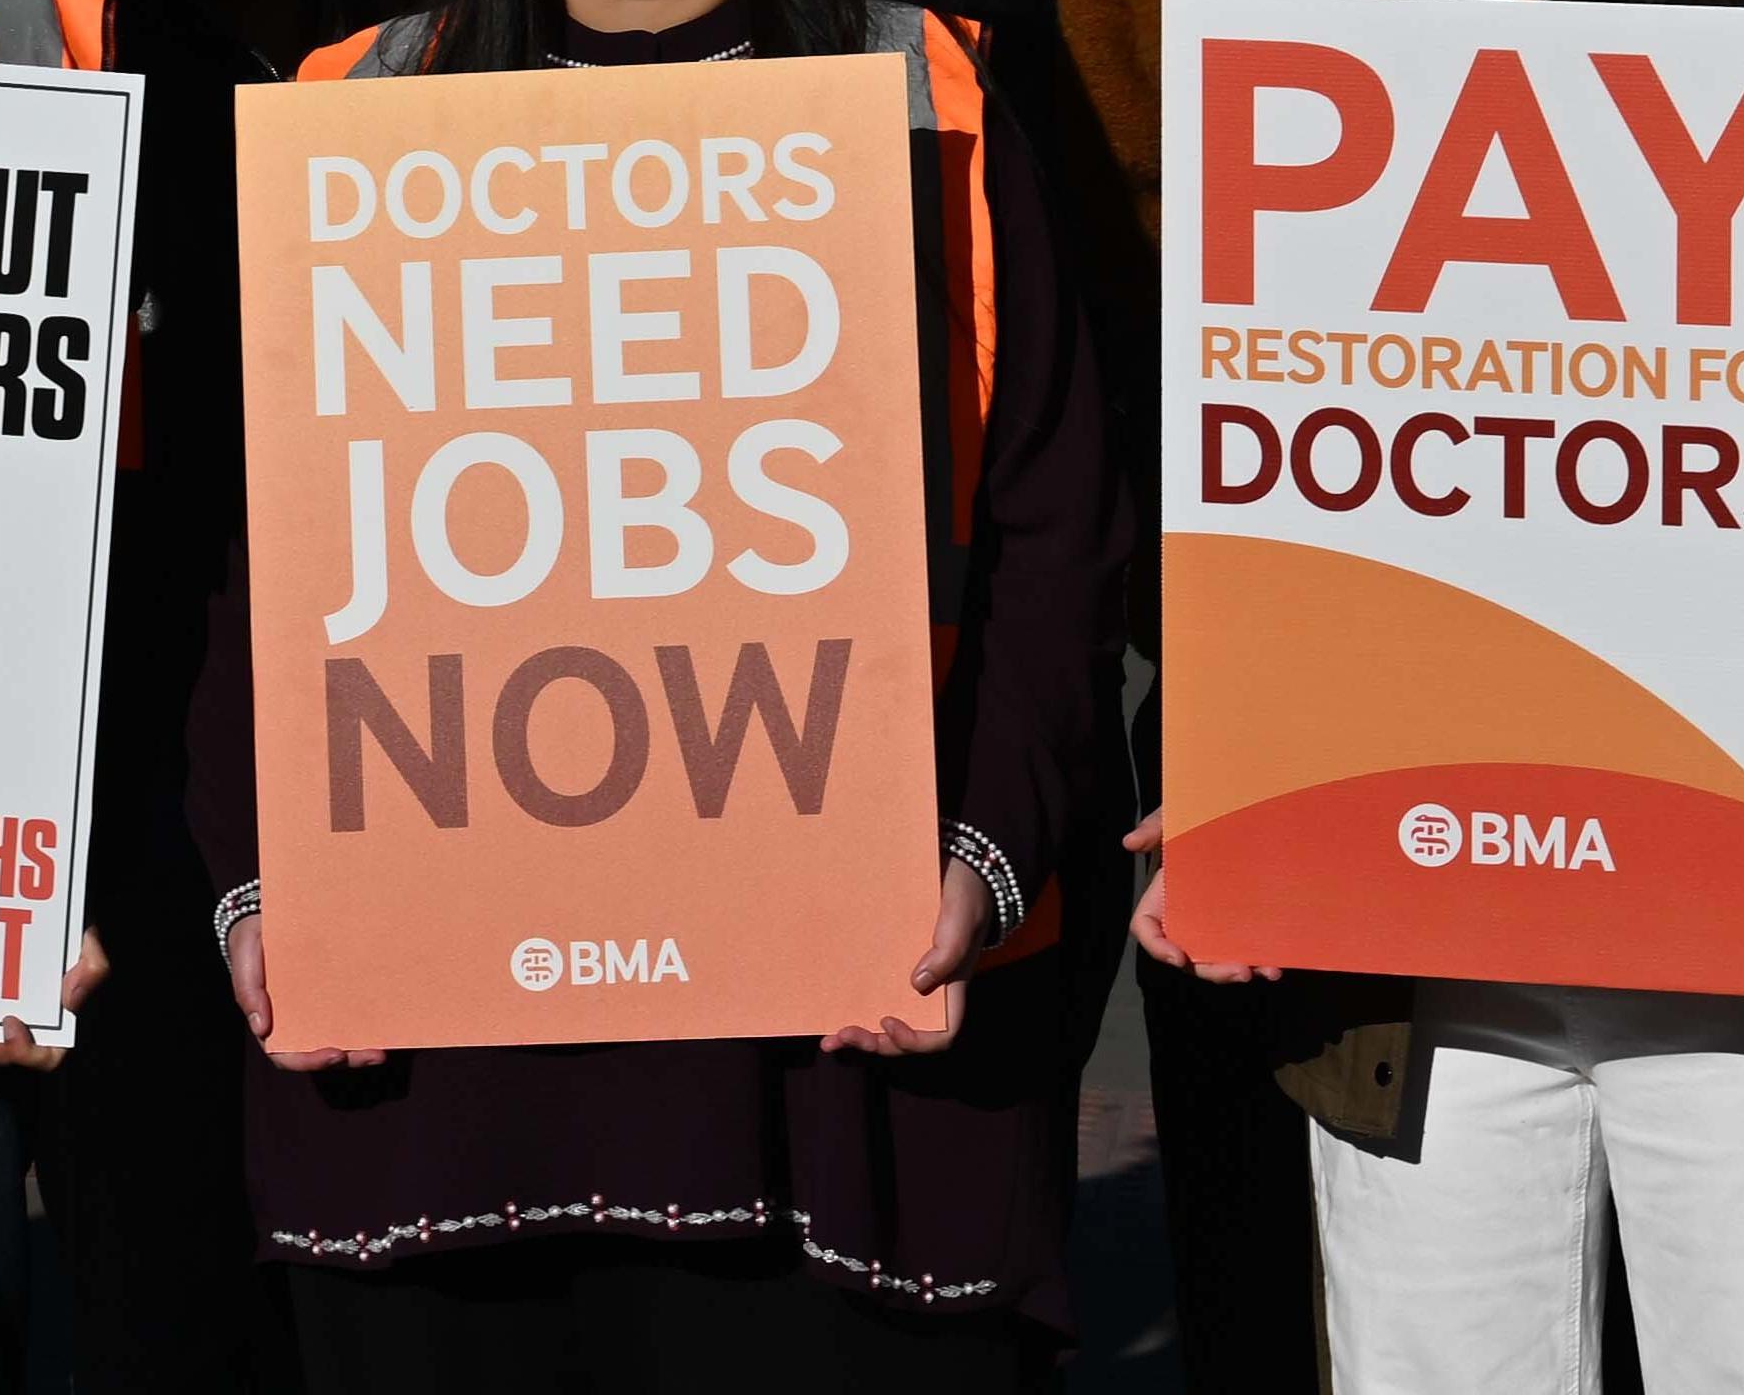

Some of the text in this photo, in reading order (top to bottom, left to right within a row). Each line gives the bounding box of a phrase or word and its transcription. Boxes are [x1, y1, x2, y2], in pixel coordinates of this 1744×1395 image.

[308, 132, 837, 243] DOCTORS
[311, 245, 842, 416] NEED
[1200, 326, 1668, 401] RESTORATION
[323, 419, 850, 646] JOBS
[325, 638, 853, 833] NOW
[1470, 812, 1616, 873] BMA
[570, 938, 689, 987] BMA
